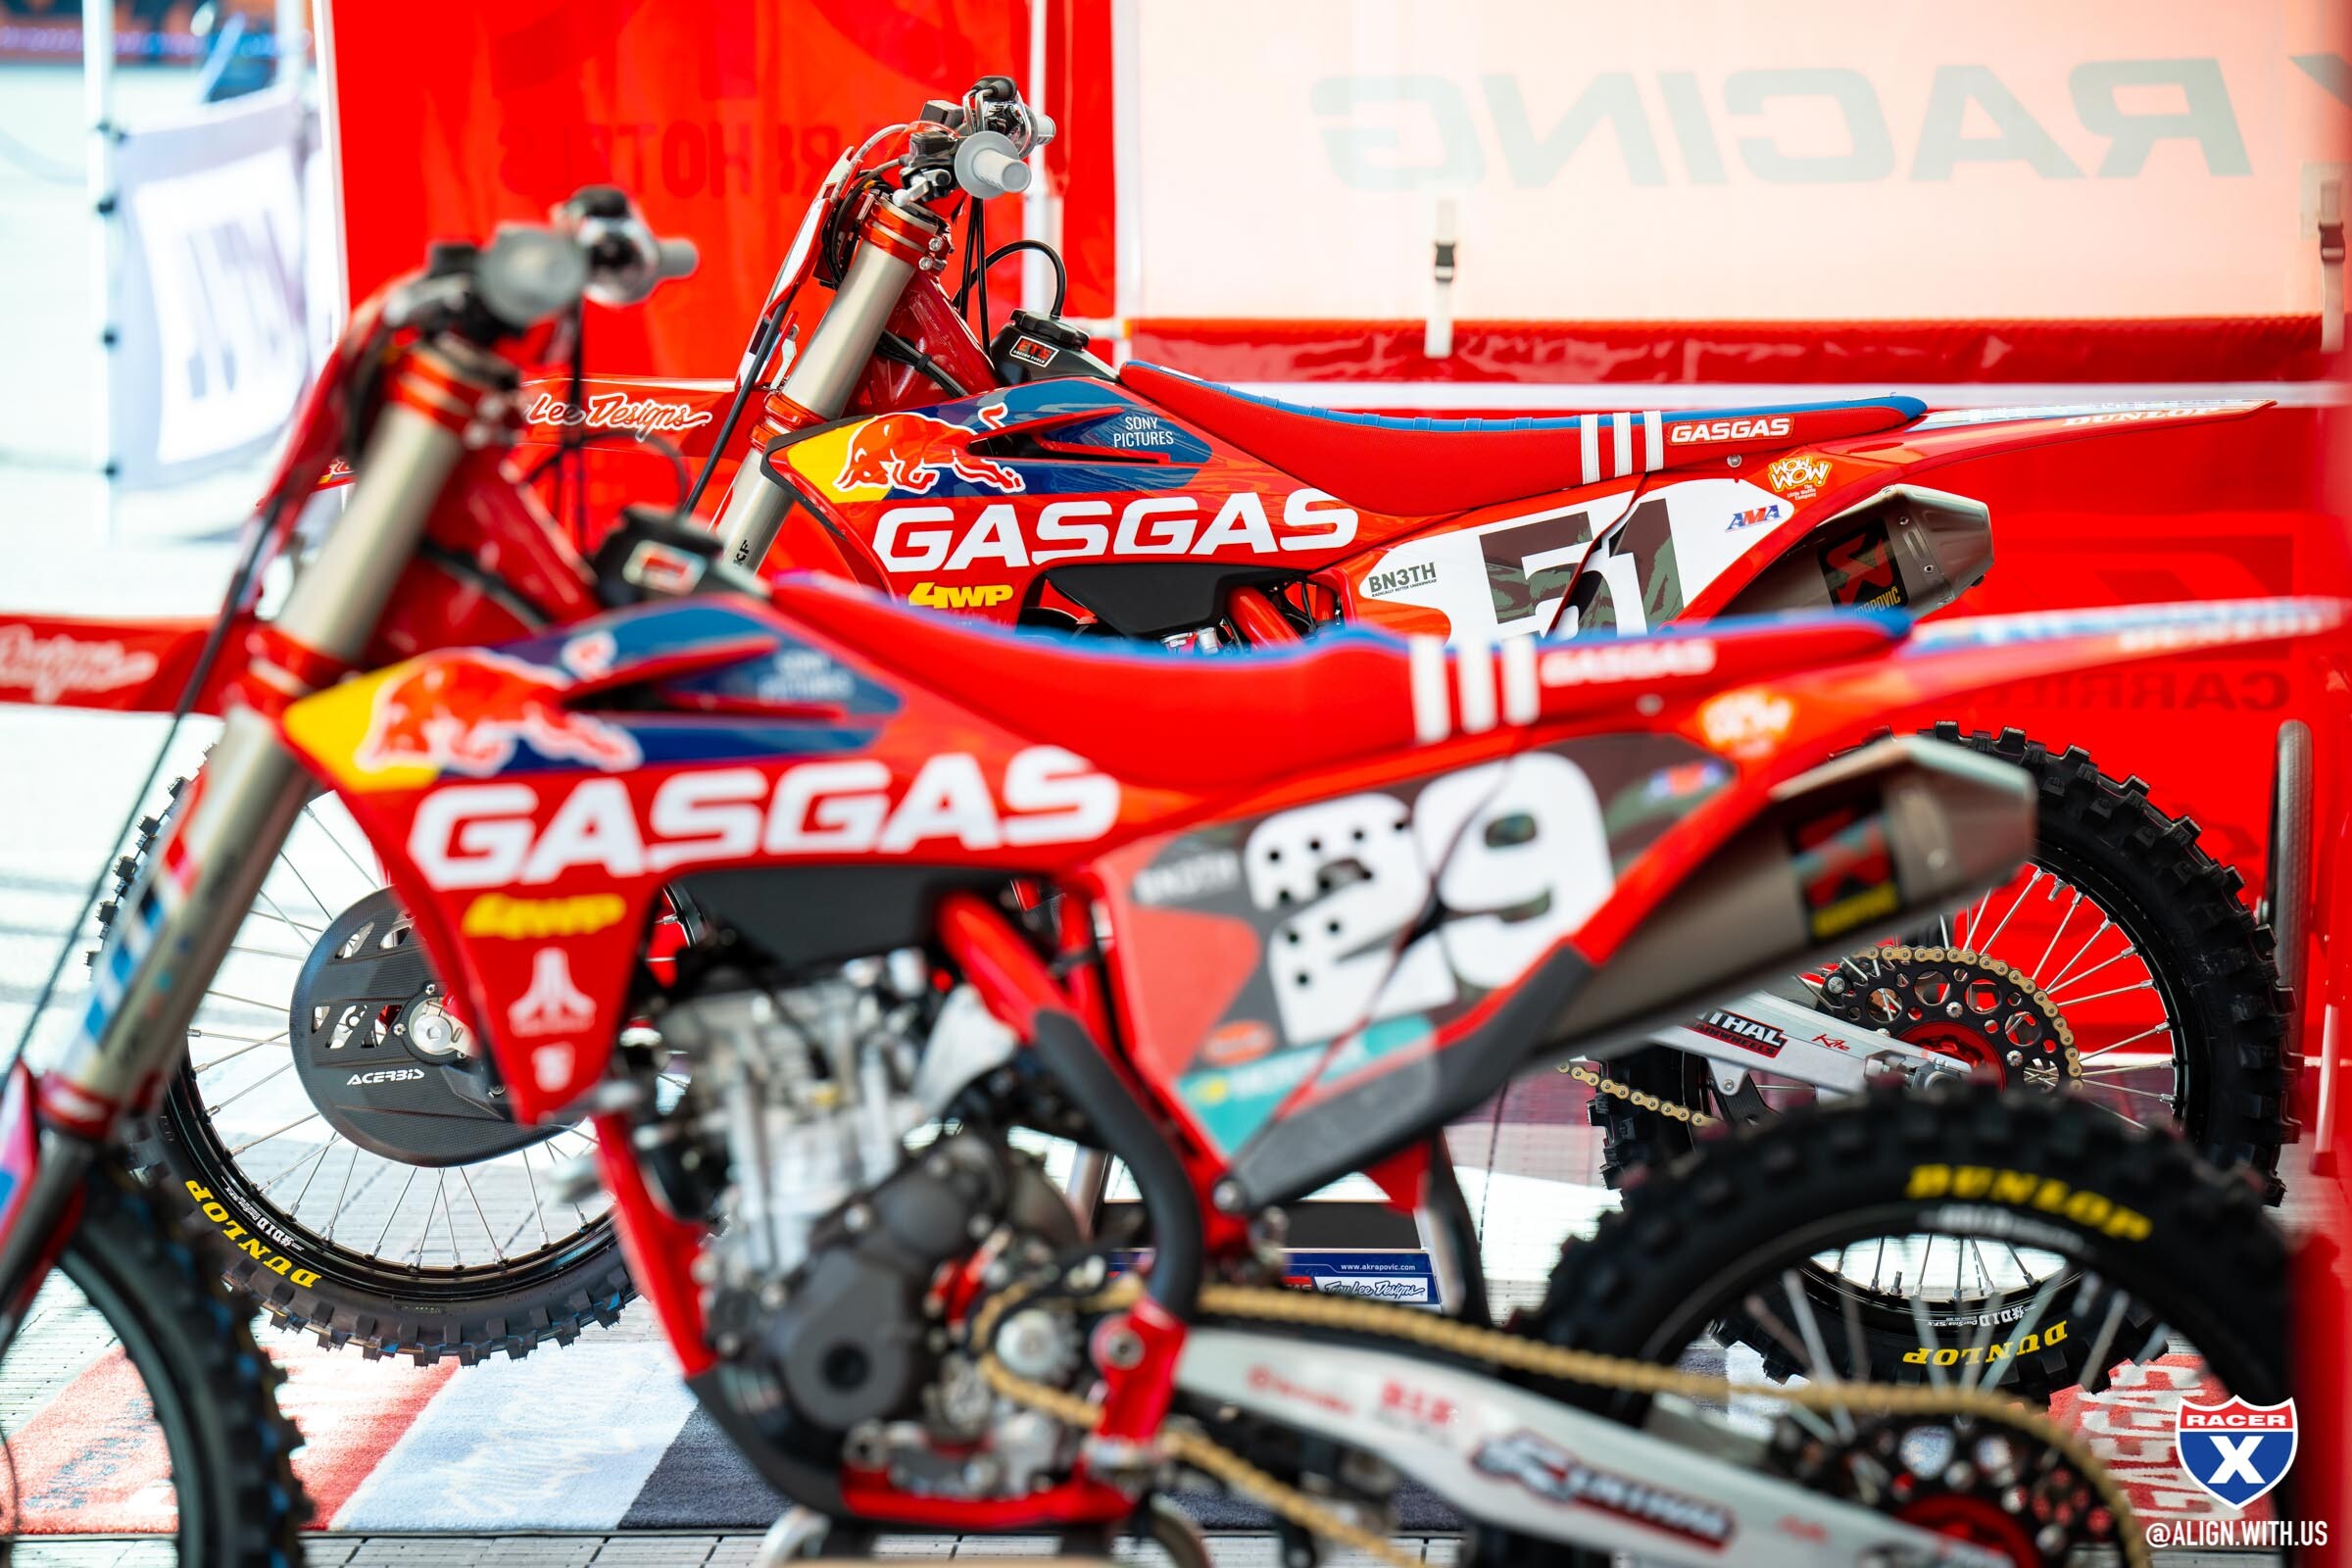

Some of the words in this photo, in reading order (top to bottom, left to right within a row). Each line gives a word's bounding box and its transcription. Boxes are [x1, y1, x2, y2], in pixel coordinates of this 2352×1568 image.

[1016, 338, 1054, 361] ETS
[525, 392, 586, 425] Lee
[586, 392, 713, 443] Designs
[1124, 416, 1158, 430] SONY
[1671, 417, 1790, 443] GASGAS
[2061, 407, 2222, 427] DUNLOP
[1113, 431, 1174, 448] PICTURES
[1772, 457, 1812, 475] WOW
[872, 488, 1358, 572] GASGAS
[1726, 505, 1782, 532] AMA
[1368, 562, 1437, 593] BN3TH
[408, 745, 1124, 890] GASGAS
[1245, 752, 1617, 1045] 29
[185, 1179, 322, 1289] DUNLOP
[1351, 1281, 1374, 1297] Lee
[1374, 1280, 1426, 1299] Designs
[1902, 1320, 2068, 1366] DUNLOP
